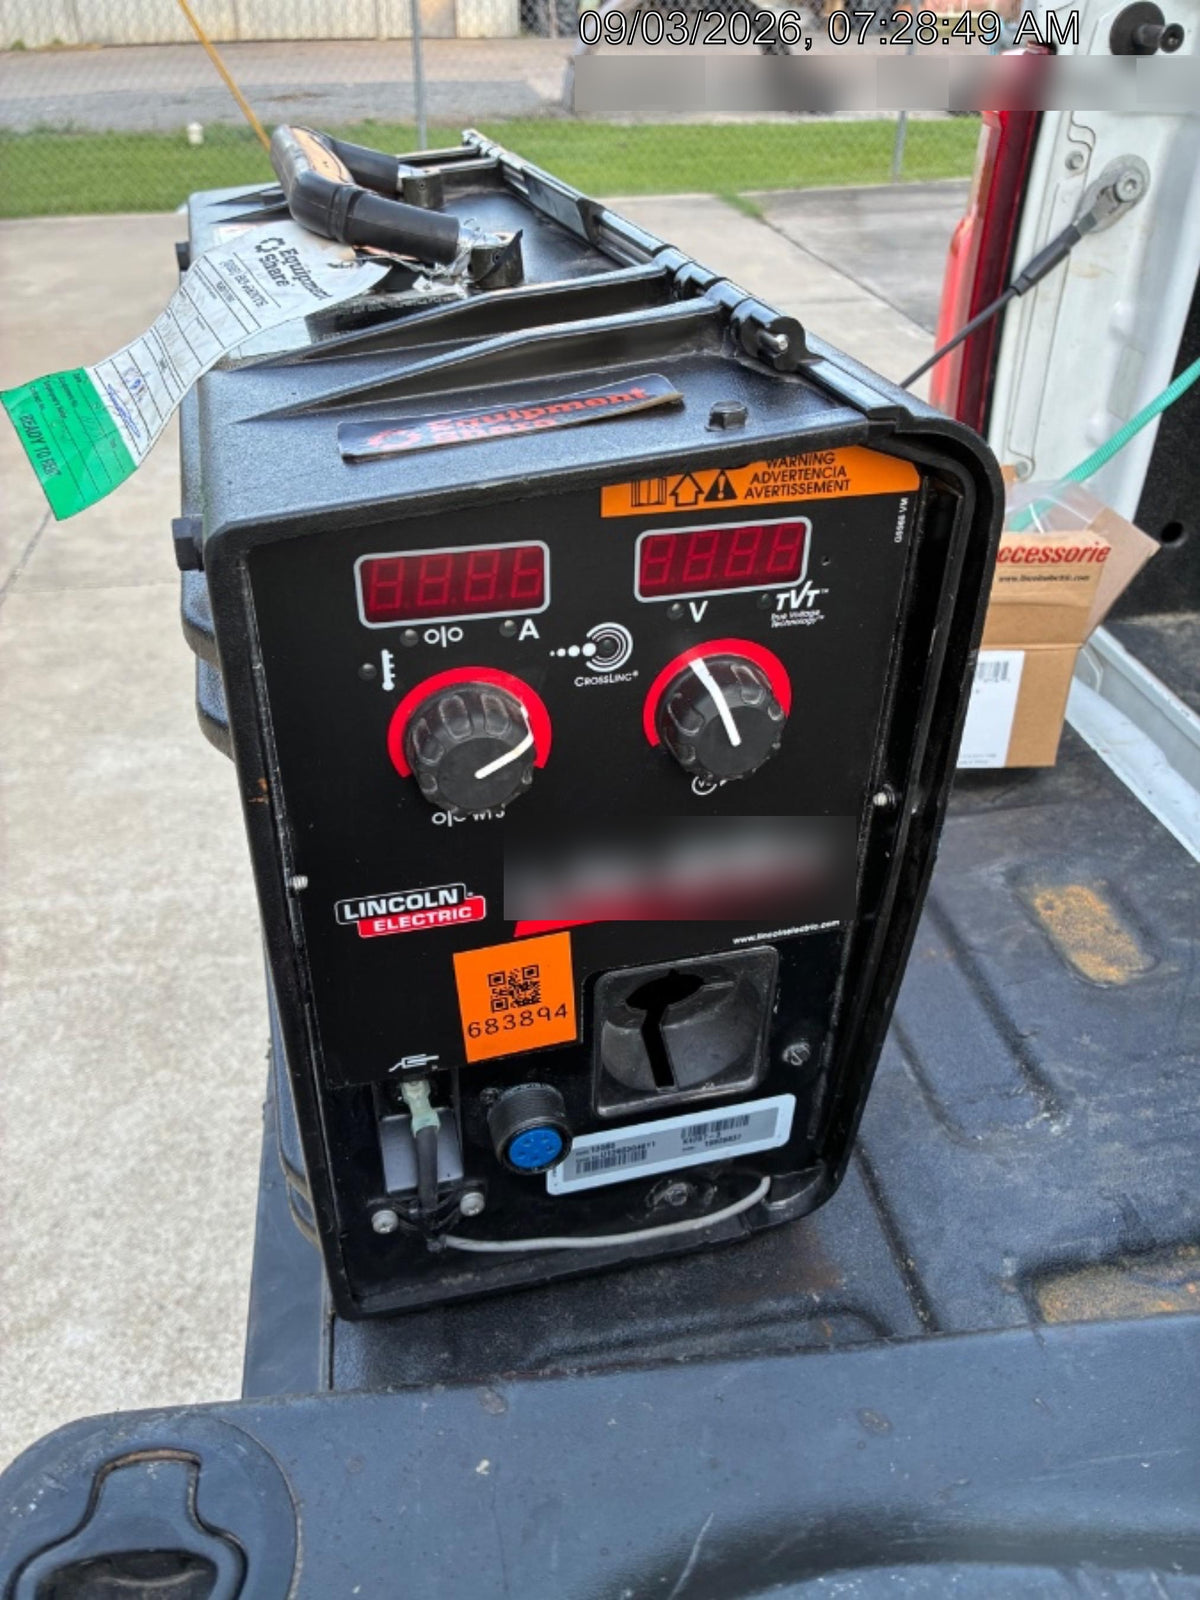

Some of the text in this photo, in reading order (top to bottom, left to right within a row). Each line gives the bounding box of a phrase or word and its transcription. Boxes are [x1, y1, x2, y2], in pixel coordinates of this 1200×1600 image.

[767, 451, 835, 469] WARNING
[750, 465, 848, 485] ADVERTENCIA
[744, 479, 851, 500] AVERTISSEMENT
[688, 600, 708, 624] V
[518, 619, 540, 641] A
[344, 888, 459, 920] LINCOLN
[373, 906, 473, 932] ELECTRIC
[732, 920, 840, 945] www.lincolnelectric.com
[468, 1003, 568, 1039] 683894
